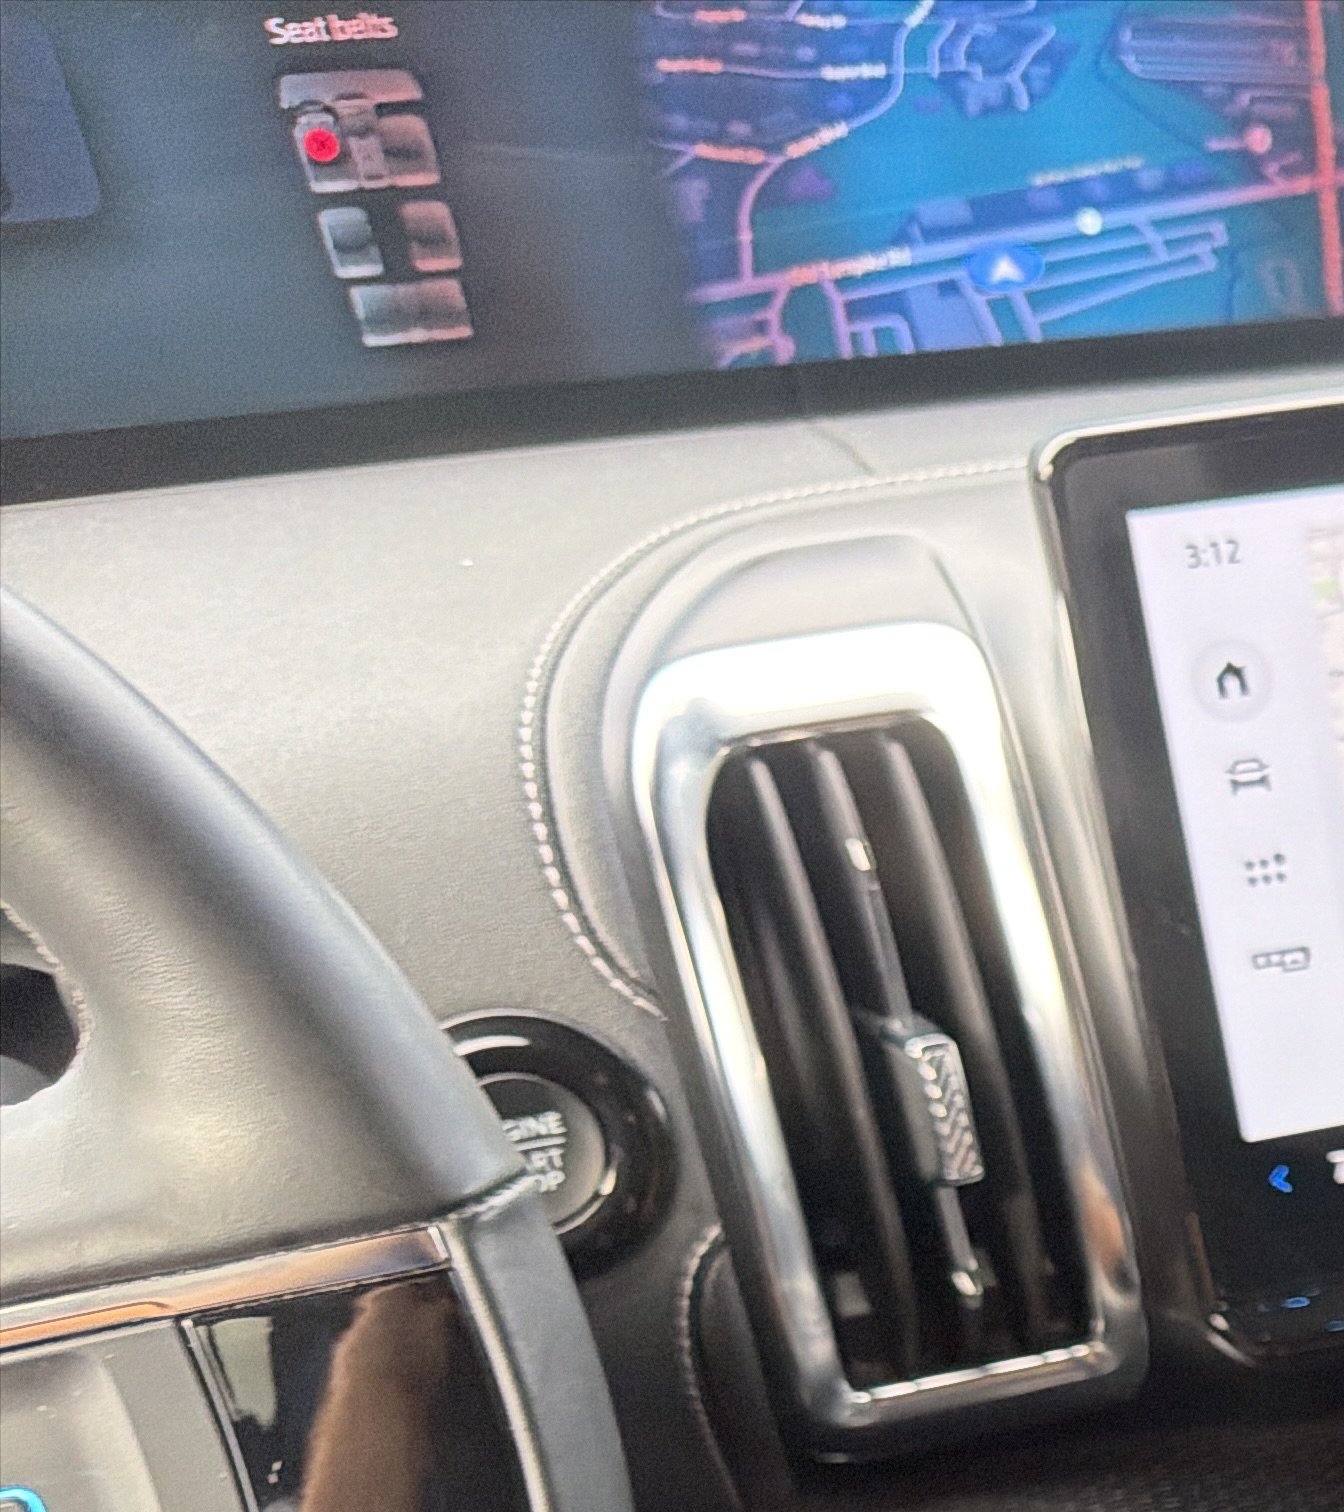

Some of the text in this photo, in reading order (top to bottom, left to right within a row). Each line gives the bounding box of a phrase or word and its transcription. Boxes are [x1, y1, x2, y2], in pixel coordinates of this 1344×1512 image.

[264, 12, 399, 45] Seat belts
[1185, 539, 1241, 569] 3:12
